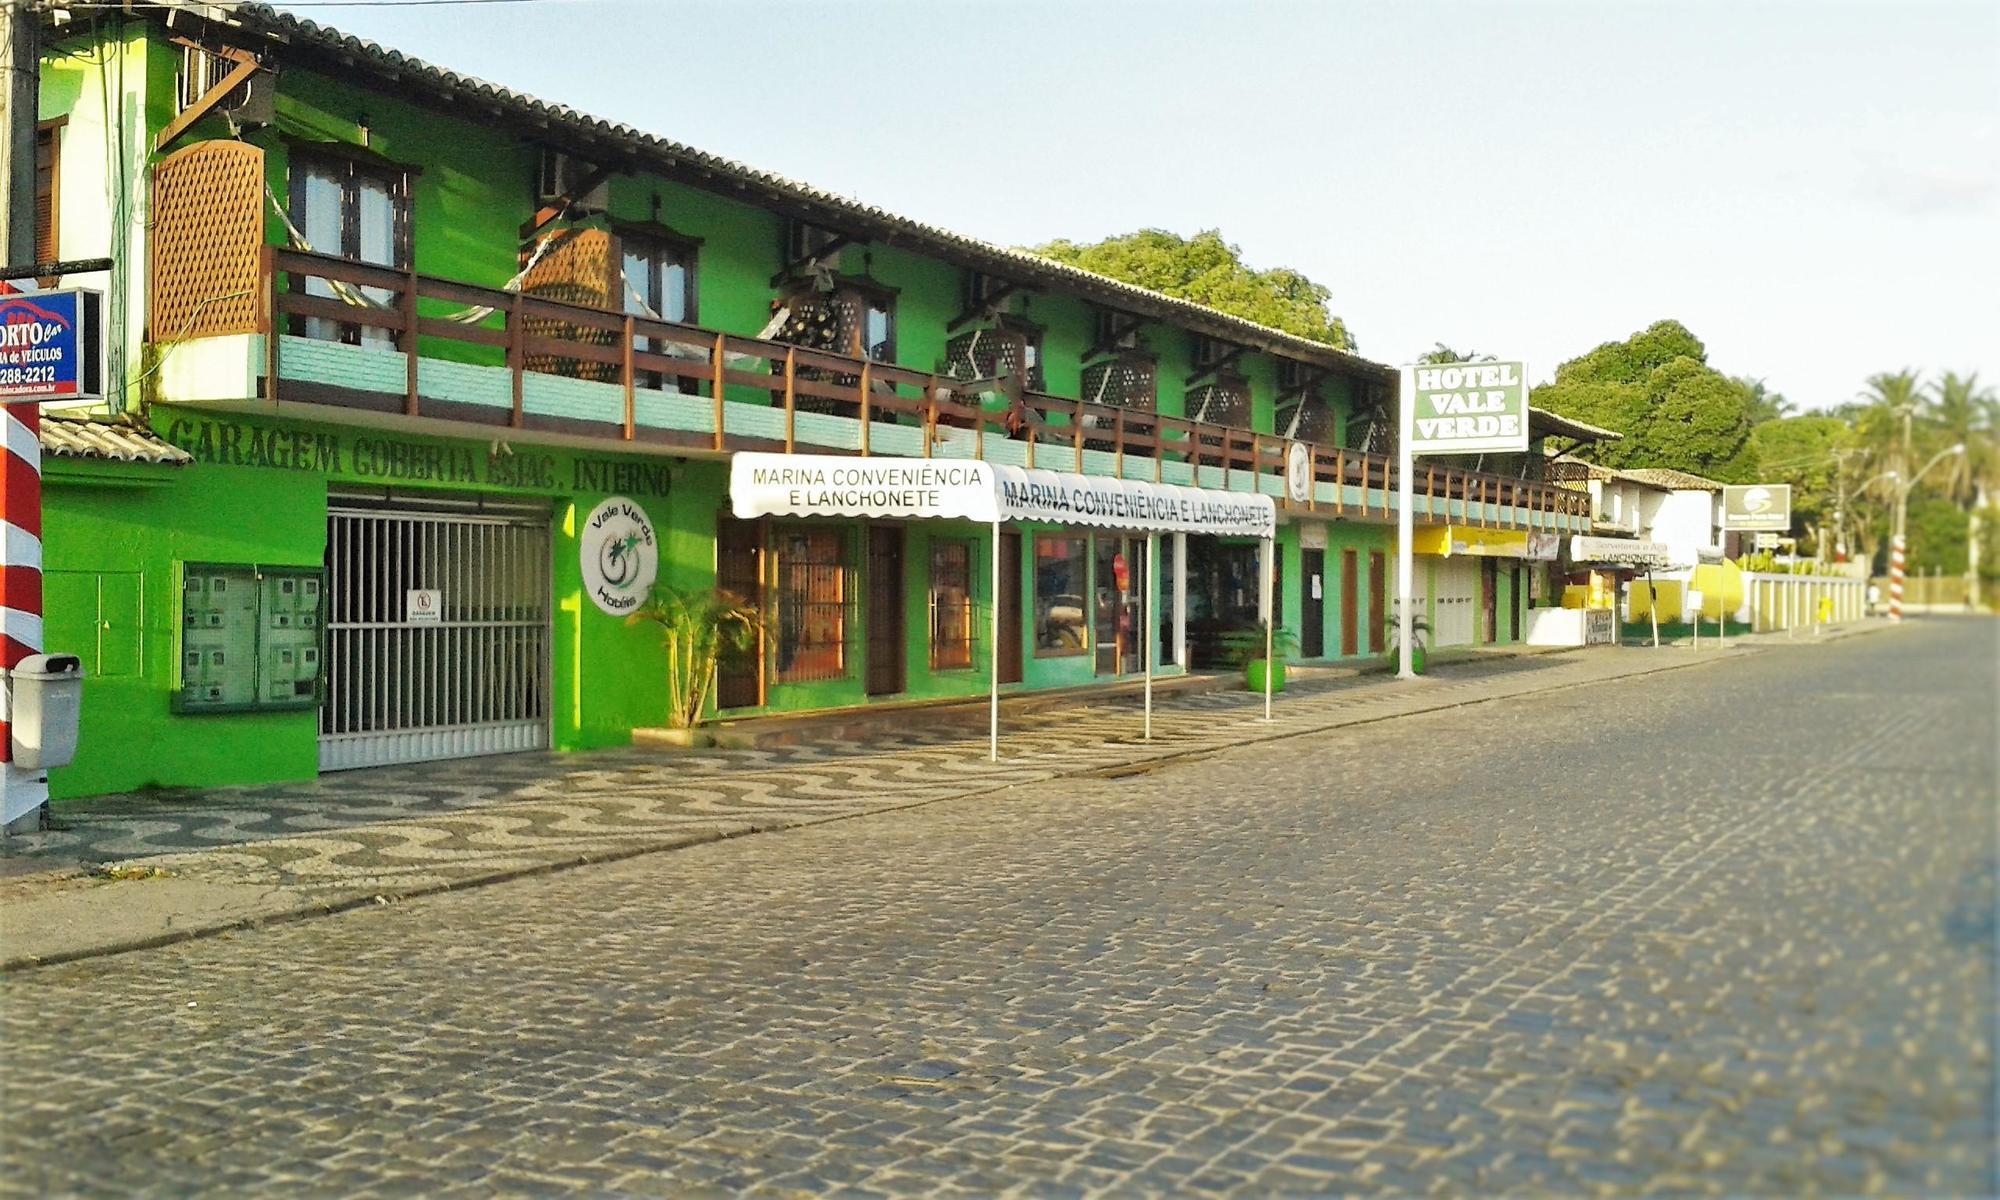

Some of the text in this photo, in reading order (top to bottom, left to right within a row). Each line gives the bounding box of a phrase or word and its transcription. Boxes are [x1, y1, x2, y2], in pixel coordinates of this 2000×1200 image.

[9, 350, 20, 363] de
[21, 346, 62, 363] VEÍCULOS
[1417, 365, 1519, 391] HOTEL
[1429, 390, 1506, 415] VALE
[1416, 414, 1519, 440] VERDE
[169, 419, 342, 473] GARAGEM
[352, 437, 476, 482] COBERTA
[573, 457, 672, 497] INTERNO
[753, 464, 982, 486] MARINA CONVENIÊNCIA
[789, 490, 940, 508] E LANCHONETE
[1003, 480, 1271, 528] MARINA CONVENIÊNCIA E LANCHONETE
[592, 504, 653, 546] Vale Verde
[597, 586, 637, 609] Hotéis
